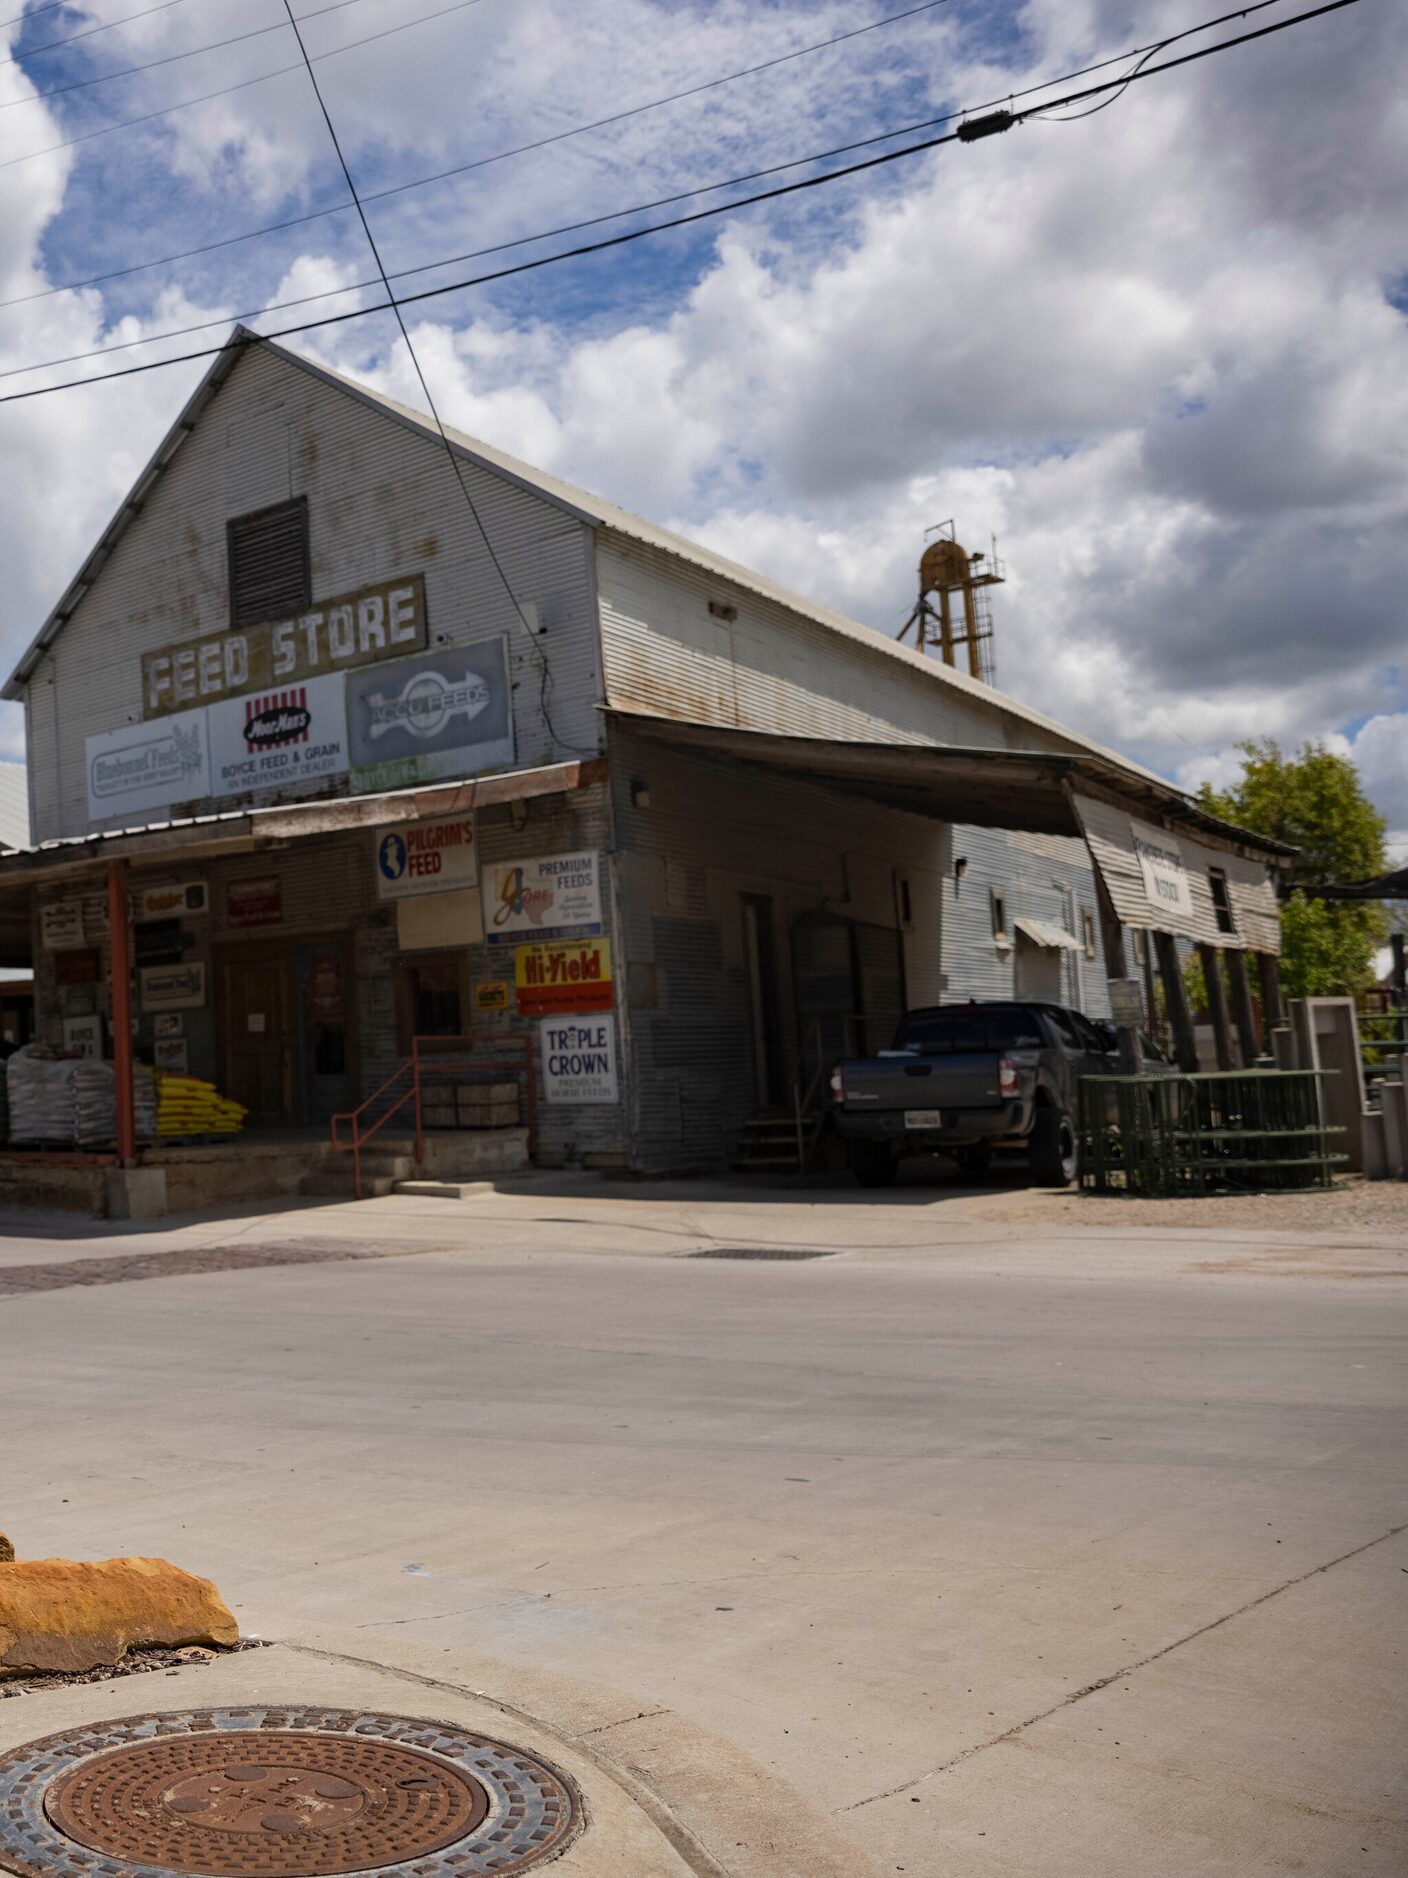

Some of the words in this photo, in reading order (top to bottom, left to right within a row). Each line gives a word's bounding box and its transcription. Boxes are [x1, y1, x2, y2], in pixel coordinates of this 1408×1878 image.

[148, 635, 249, 709] FEED
[271, 586, 416, 676] STORE
[428, 687, 490, 713] FEEDS
[221, 759, 256, 779] BOYCE
[260, 754, 288, 770] FEED
[292, 751, 301, 764] &
[304, 741, 340, 761] GRAIN
[241, 766, 298, 786] INDEPENDENT
[300, 758, 336, 775] DEALER
[407, 821, 473, 854] PILGRIM'S
[408, 852, 441, 878] FEED
[539, 857, 593, 877] PREMIUM
[557, 873, 593, 890] FEEDS
[525, 950, 601, 985] Hi-Yield
[549, 1053, 609, 1076] CROWN
[260, 1716, 467, 1758] SPECIAL
